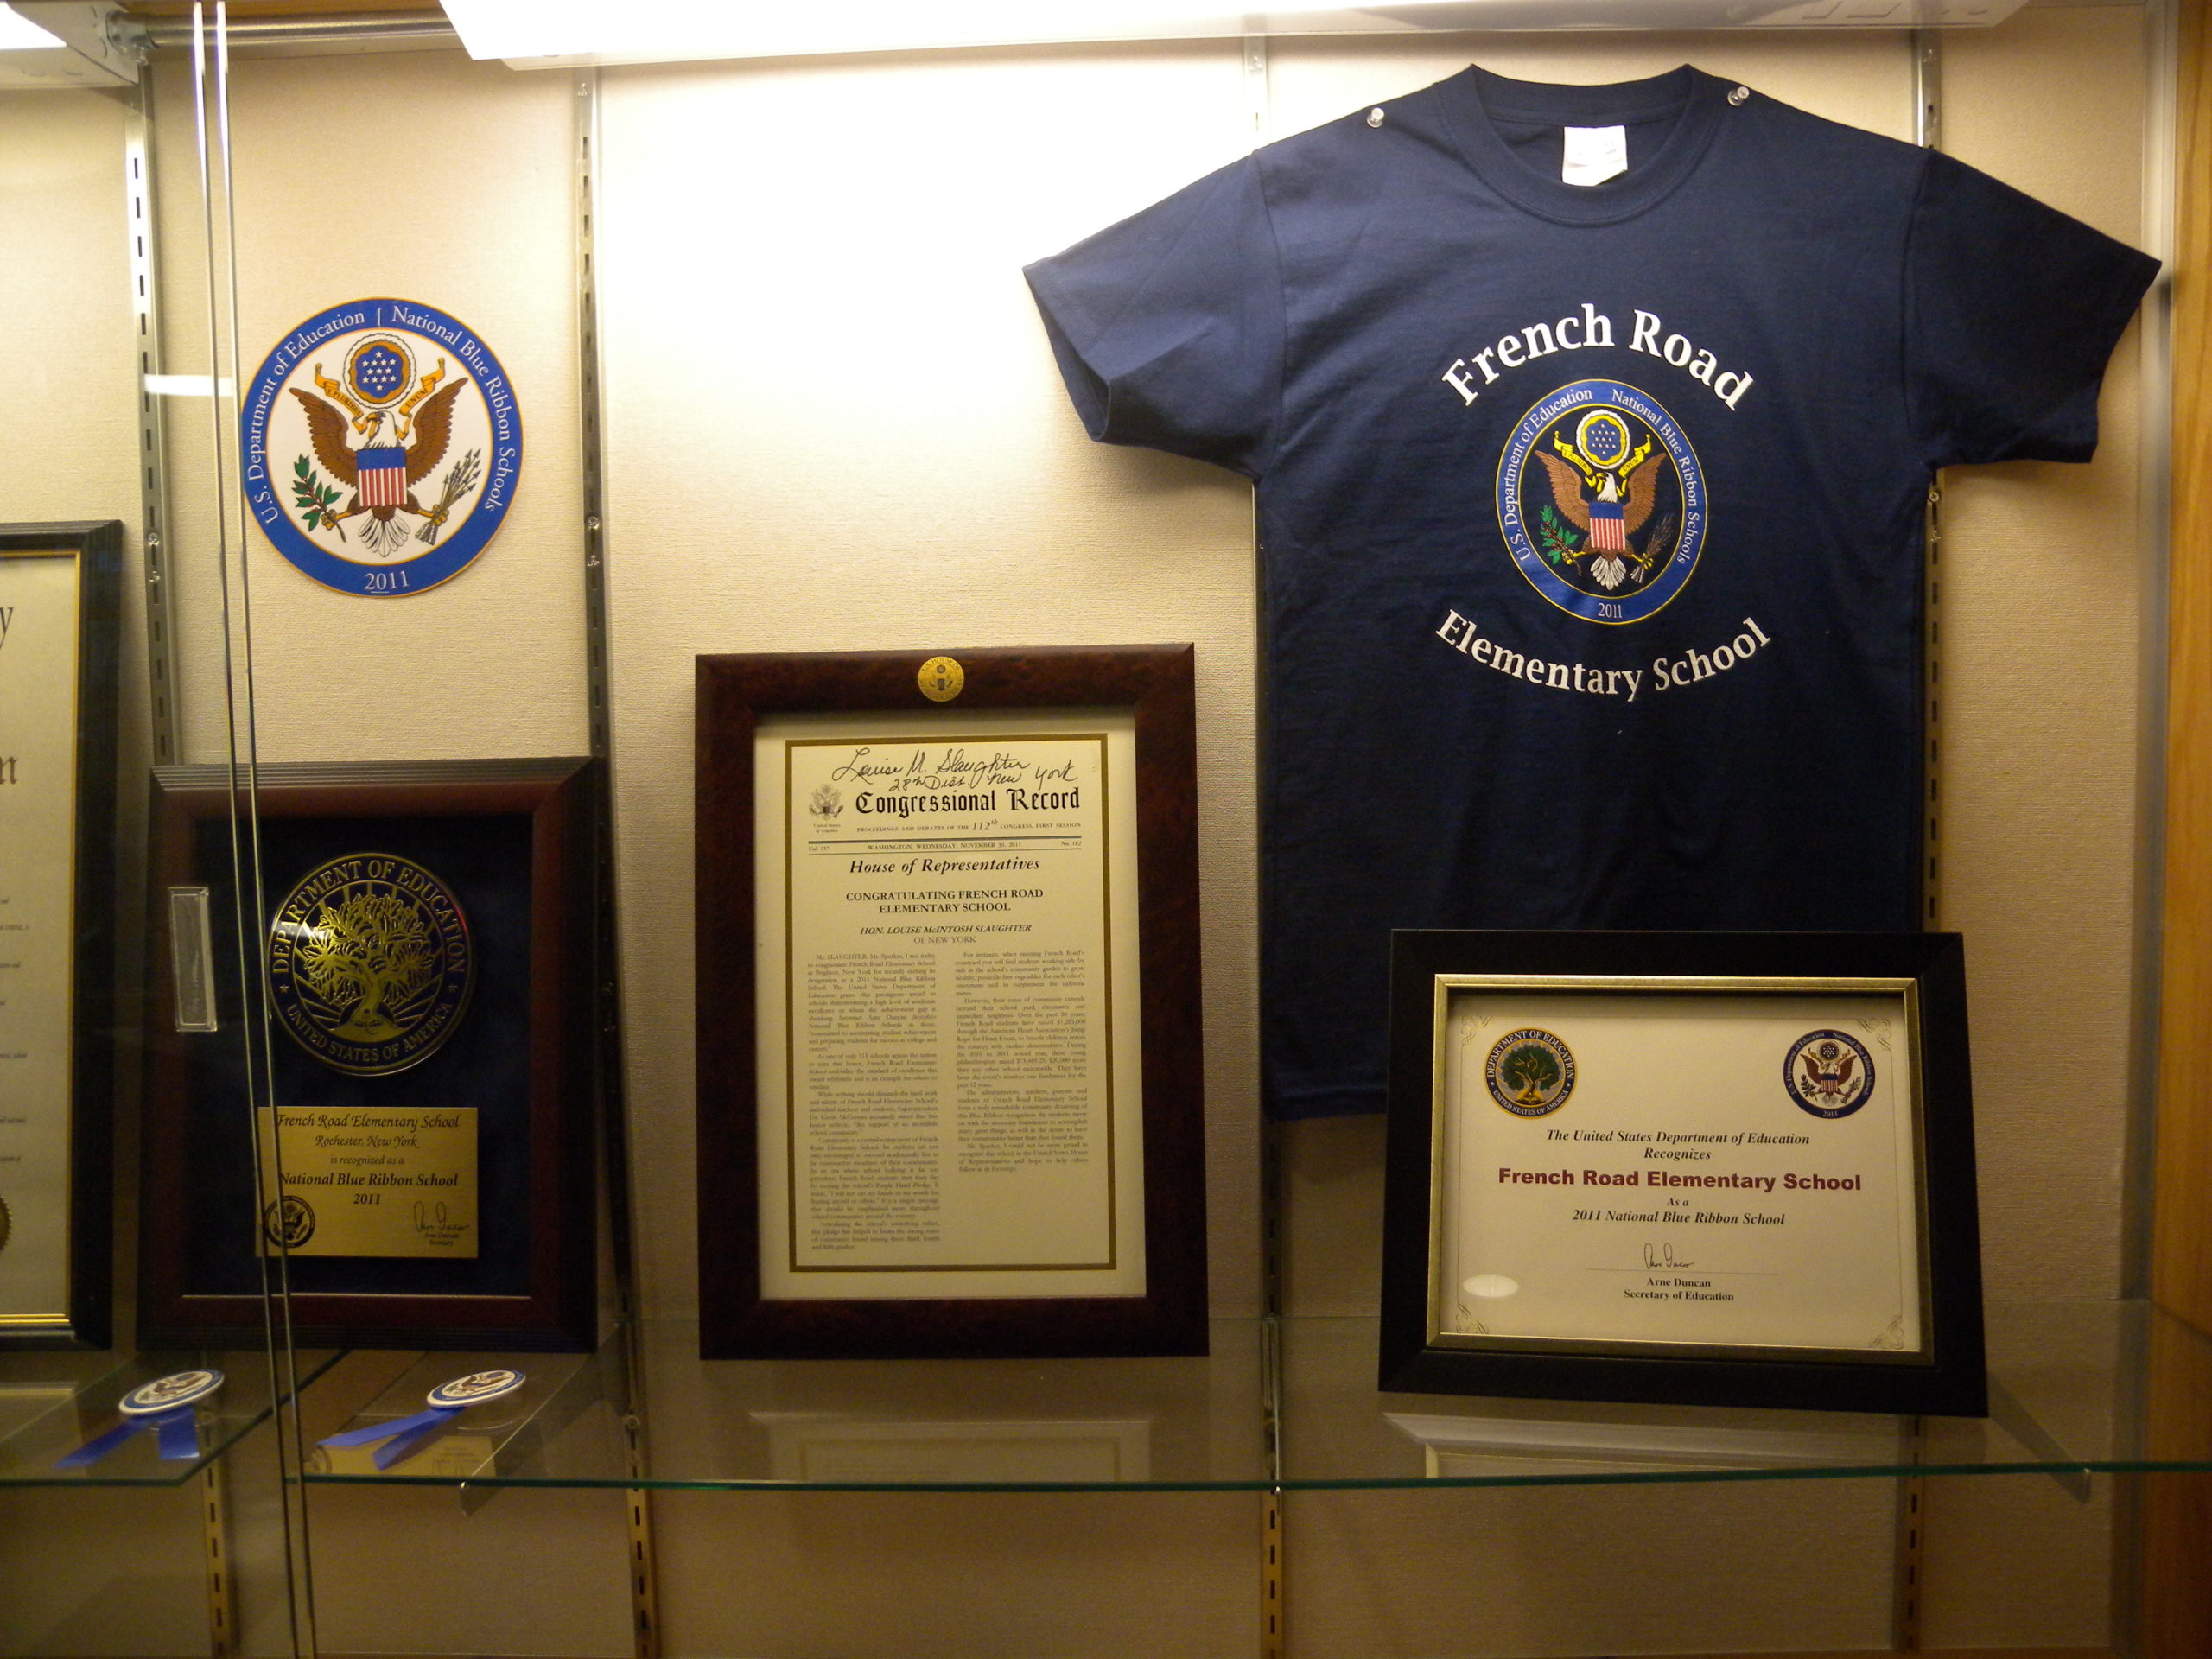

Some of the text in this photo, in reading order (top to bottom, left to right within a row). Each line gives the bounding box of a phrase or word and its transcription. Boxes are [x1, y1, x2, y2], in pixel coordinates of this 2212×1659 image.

[1441, 302, 1755, 410] French Road
[248, 311, 366, 524] U.S. Department of Education
[391, 305, 516, 512] National Blue Ribbon Schools
[1503, 389, 1593, 562] U.S. Department of Education
[1611, 388, 1700, 565] National Blue Ribbon Schools
[365, 569, 410, 592] 2011
[1597, 602, 1623, 619] 2011
[1435, 609, 1771, 702] Elementary School
[935, 748, 1031, 789] Slaughter
[855, 787, 1081, 819] Congressional Record
[849, 856, 1040, 876] House of Representatives
[846, 888, 1044, 902] CONGRATULATING FRENCH ROAD
[366, 859, 395, 880] OF
[397, 864, 466, 974] EDUCATION
[879, 902, 1012, 914] ELEMENTARY SCHOOL
[860, 926, 885, 935] HON.
[975, 924, 1033, 932] SLAUGHTER
[286, 1001, 454, 1062] UNITED STATES OF AMERICA
[1486, 1031, 1528, 1077] DEPARTMENT
[1542, 1033, 1574, 1079] EDUCATION
[1493, 1090, 1513, 1112] UNITED
[277, 1113, 461, 1133] French Road Elementary School
[366, 1135, 392, 1147] New
[392, 1135, 419, 1148] York
[1547, 1129, 1810, 1146] The United States Department of Education
[340, 1155, 385, 1166] recognized
[1643, 1147, 1712, 1162] Recognizes
[279, 1172, 459, 1186] National Blue Ribbon School
[1498, 1167, 1861, 1193] French Road Elementary School
[353, 1193, 381, 1205] 2011
[1666, 1197, 1680, 1206] As
[1572, 1209, 1786, 1225] 2011 National Blue Ribbon School
[1646, 1277, 1712, 1287] Arne Duncan
[1624, 1289, 1735, 1301] Secretary of Education
